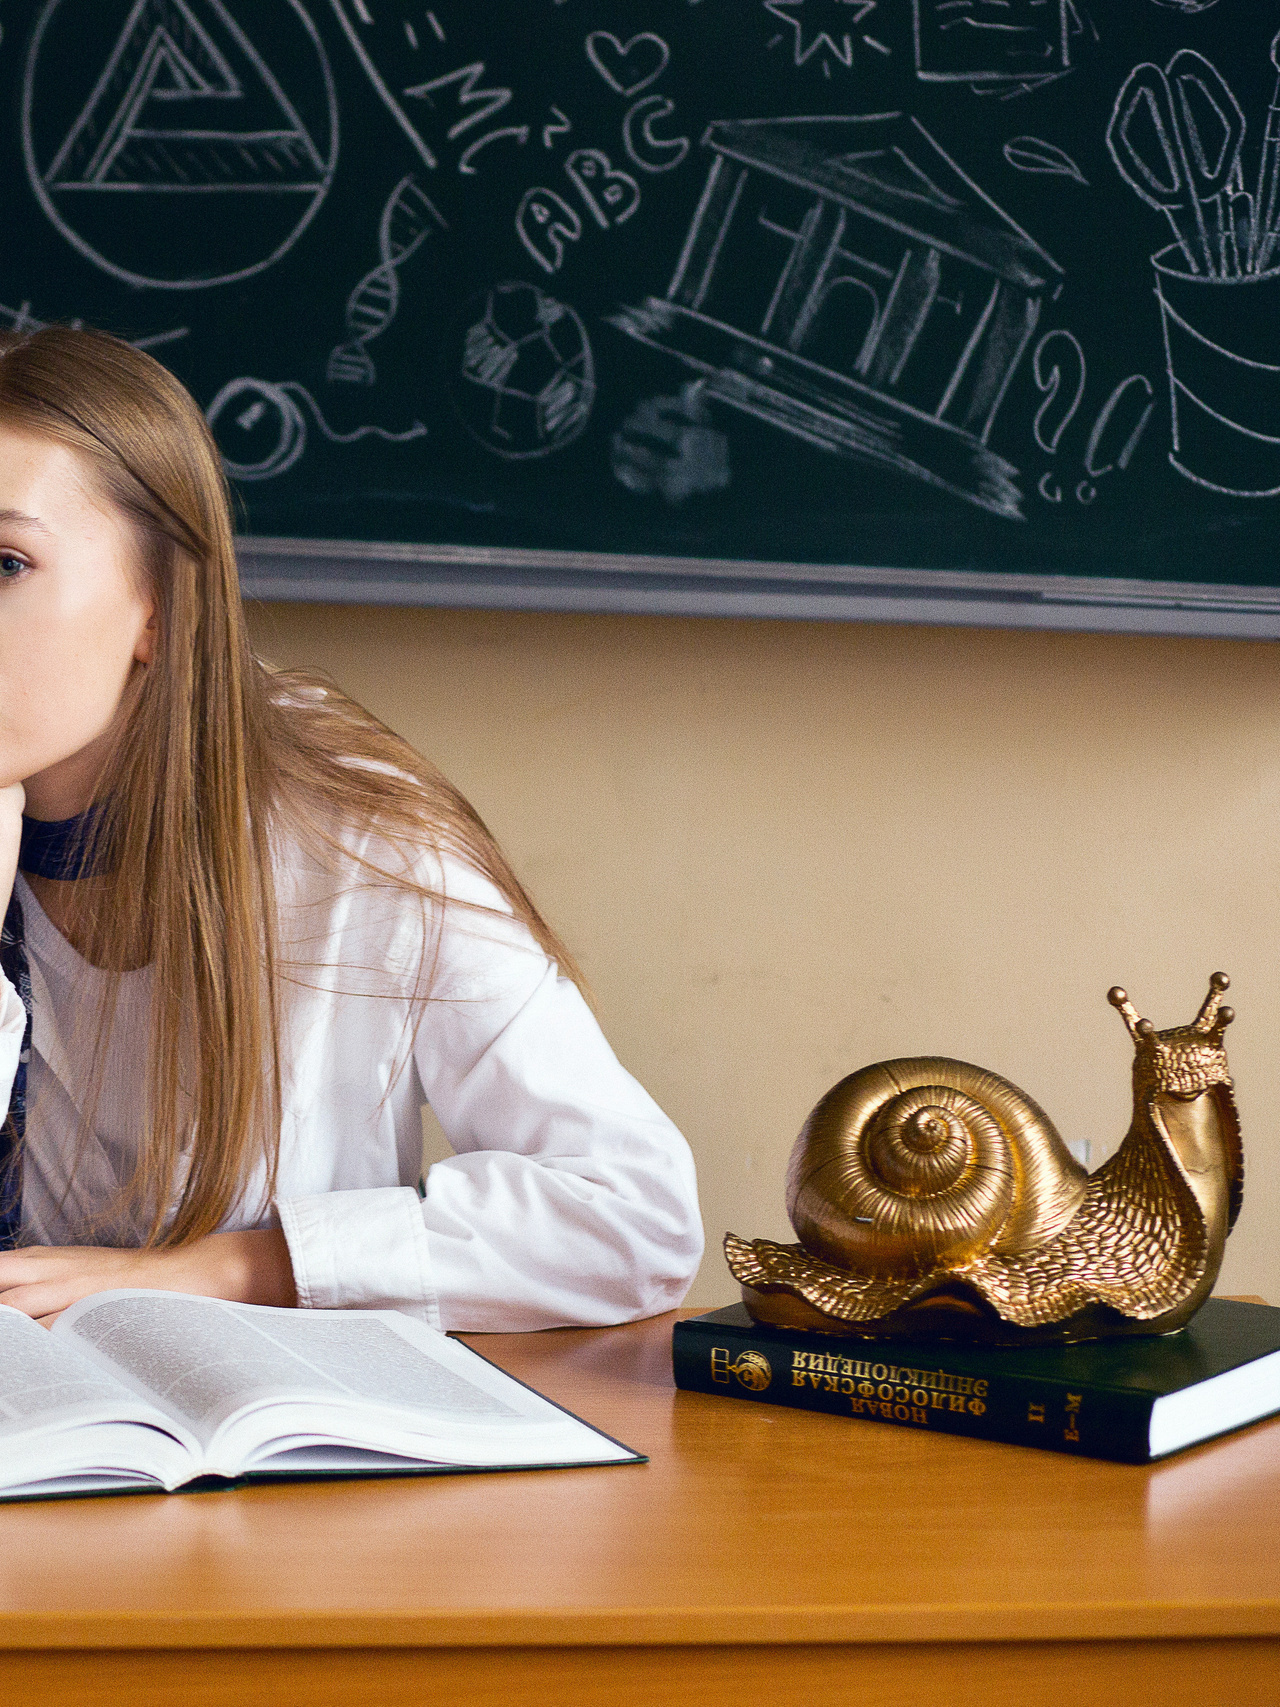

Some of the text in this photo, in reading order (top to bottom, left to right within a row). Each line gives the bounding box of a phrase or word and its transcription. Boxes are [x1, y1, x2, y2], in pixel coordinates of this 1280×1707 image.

[515, 95, 689, 273] ABC
[791, 1351, 989, 1397] ЭНЦИКЛОПЕДИЯ
[791, 1369, 987, 1416] ФИЛОСОФСКАЯ
[849, 1397, 929, 1424] НОВАЯ
